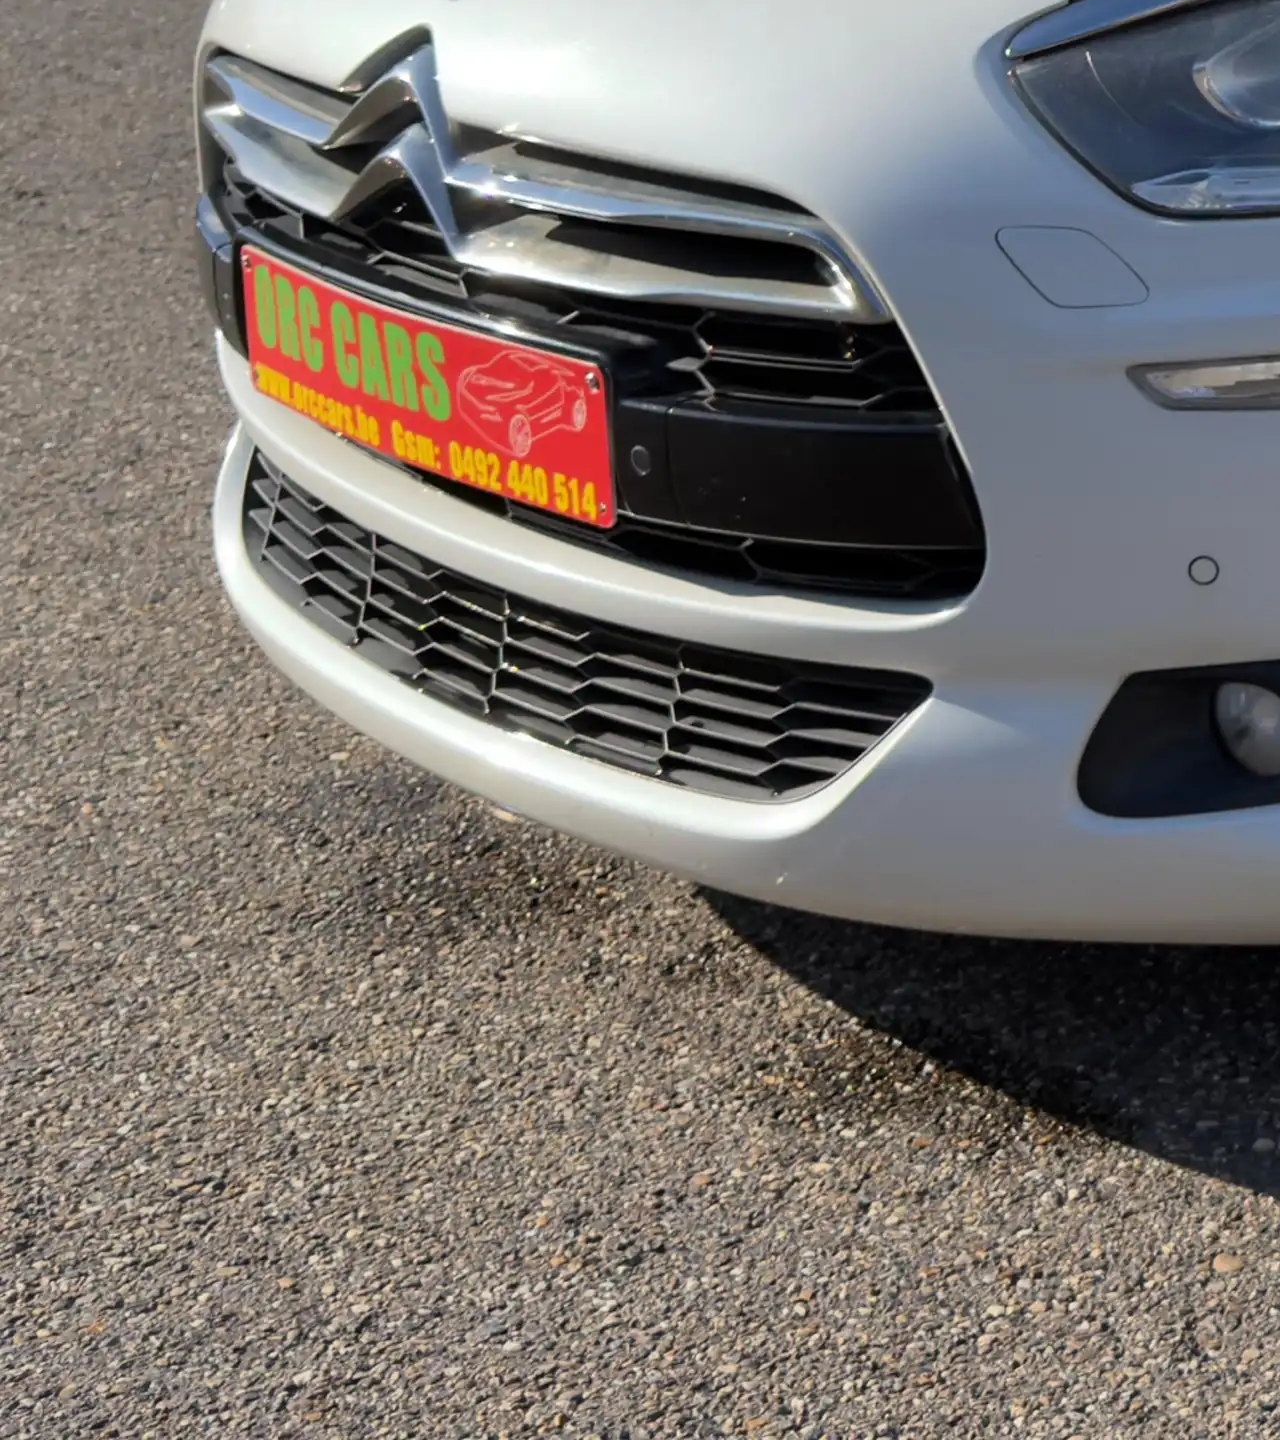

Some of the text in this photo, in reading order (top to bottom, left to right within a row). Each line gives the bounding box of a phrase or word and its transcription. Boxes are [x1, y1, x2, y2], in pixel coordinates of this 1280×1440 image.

[254, 264, 451, 422] ORC CARS
[255, 361, 597, 520] www.orccars.be Gsm: 0492 440 514
